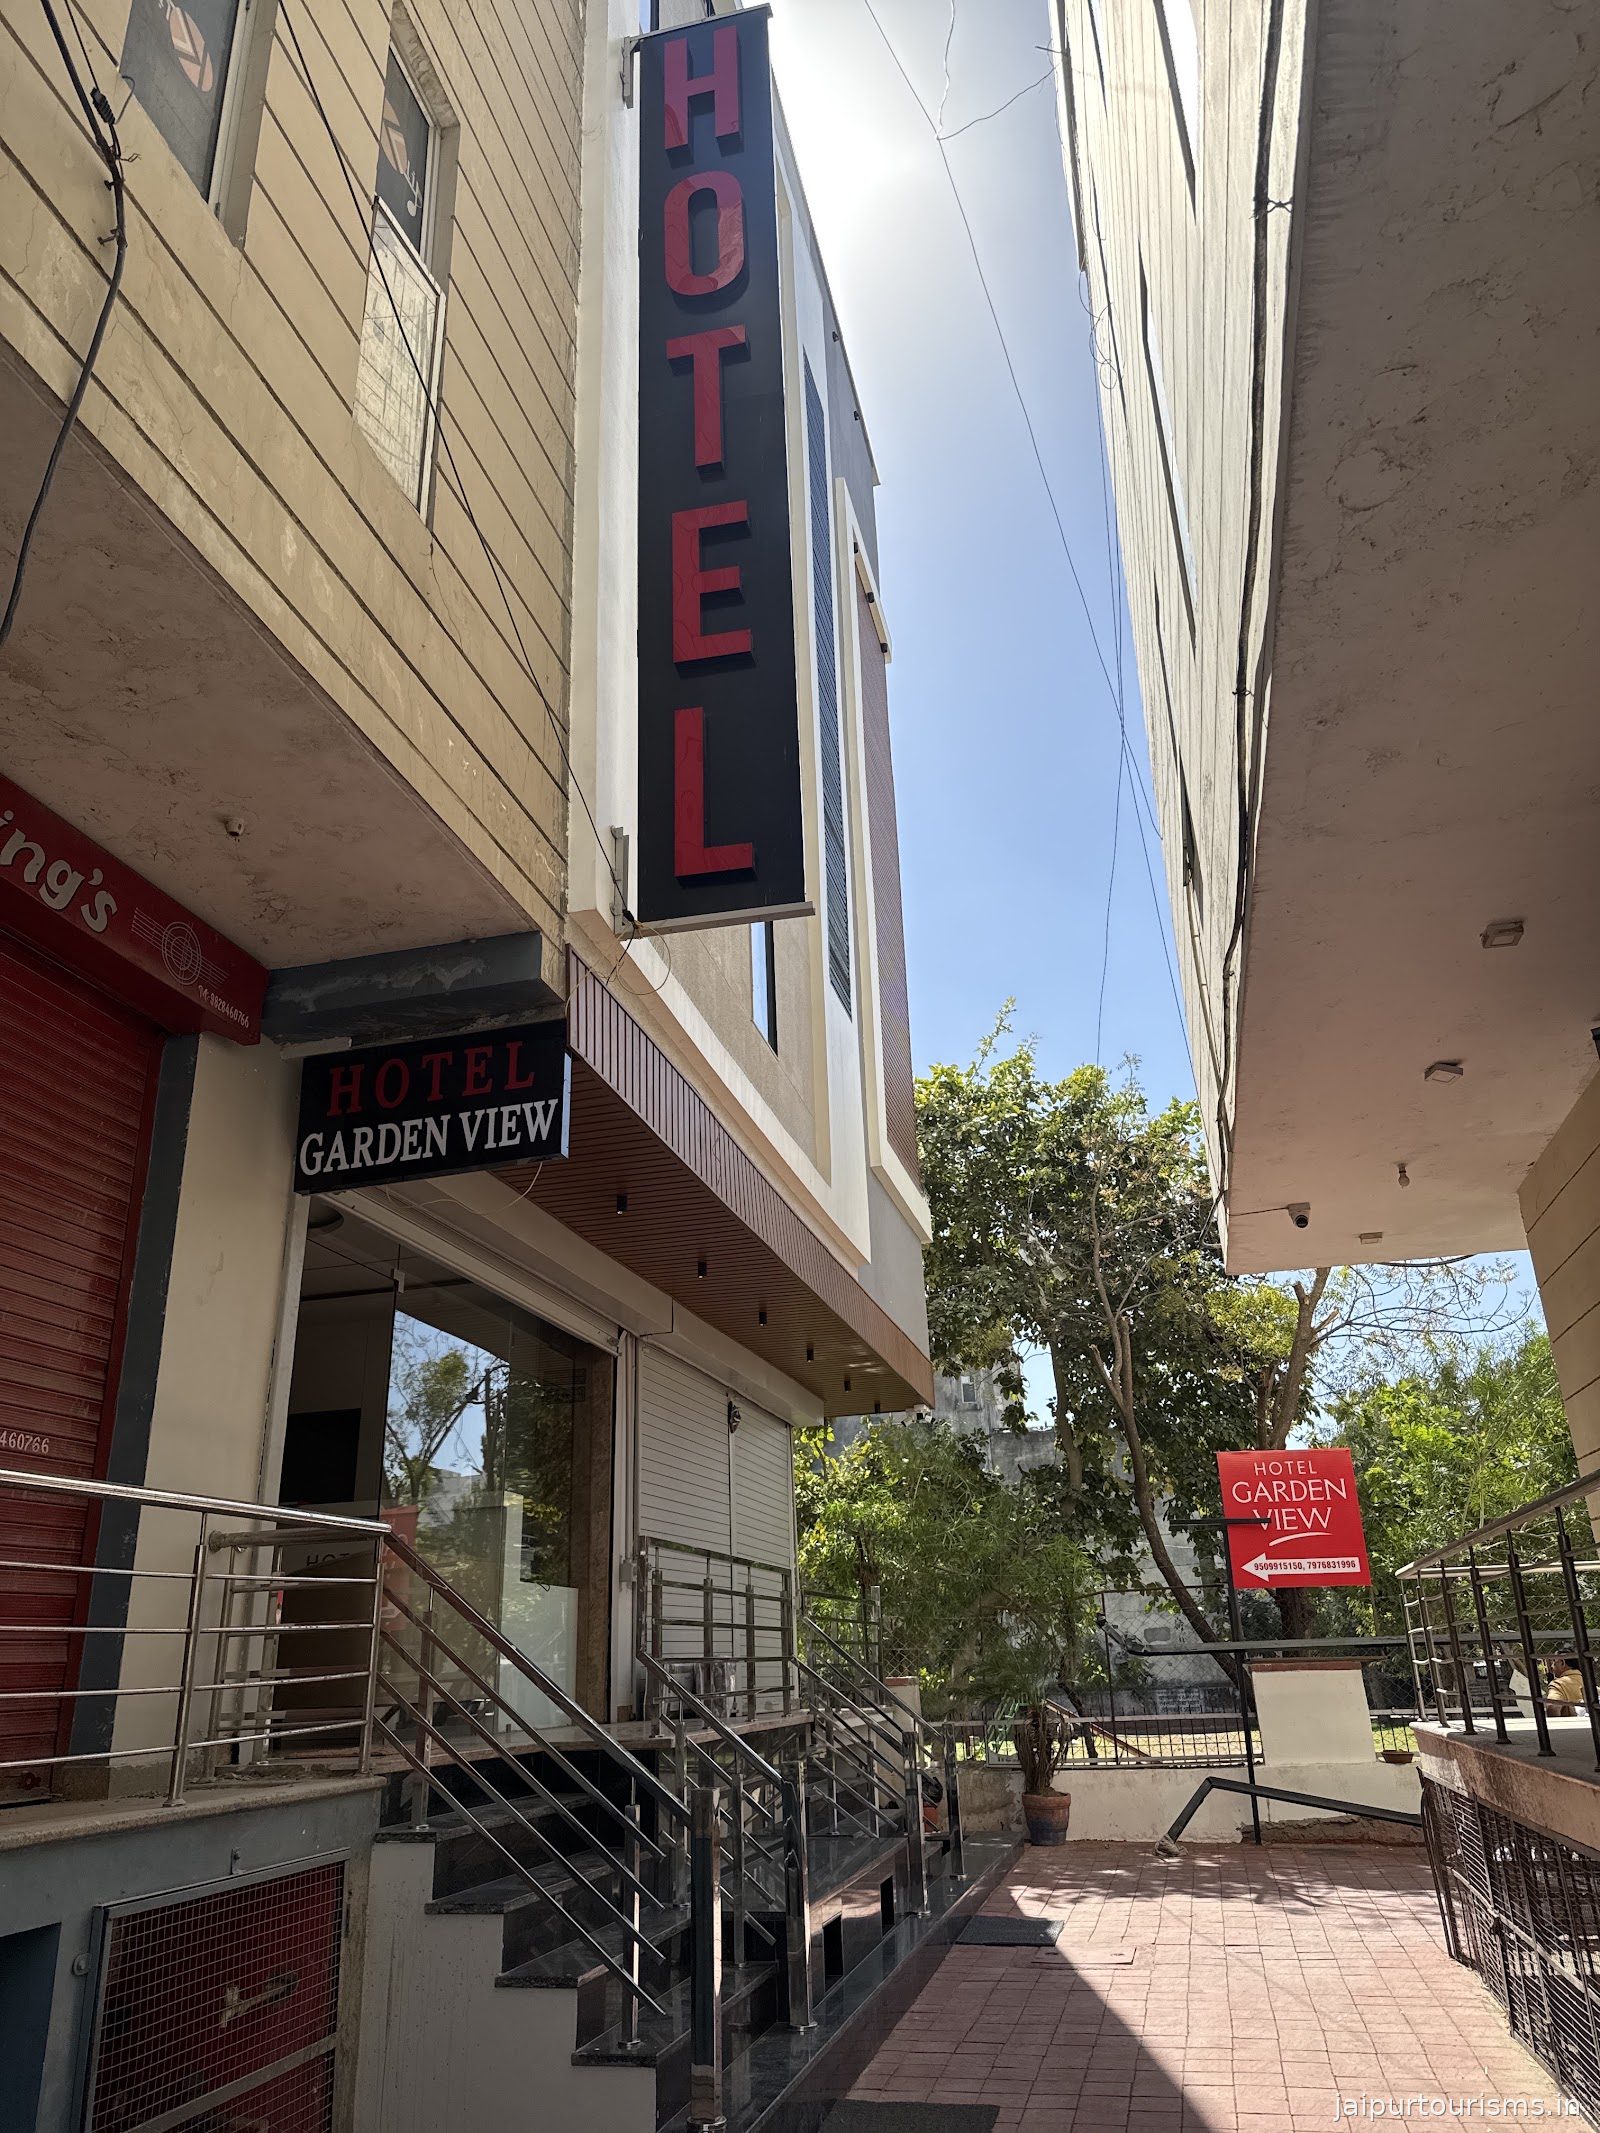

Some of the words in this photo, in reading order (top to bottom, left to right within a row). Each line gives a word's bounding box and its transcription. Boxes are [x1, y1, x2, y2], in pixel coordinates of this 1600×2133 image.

[663, 25, 755, 878] HOTEL
[327, 1041, 535, 1117] HOTEL
[299, 1114, 451, 1176] GARDEN
[459, 1098, 559, 1152] VIEW
[1254, 1460, 1318, 1476] HOTEL
[1232, 1478, 1347, 1504] GARDEN
[1252, 1507, 1332, 1531] VIEW
[1307, 1560, 1356, 1569] 7976831996
